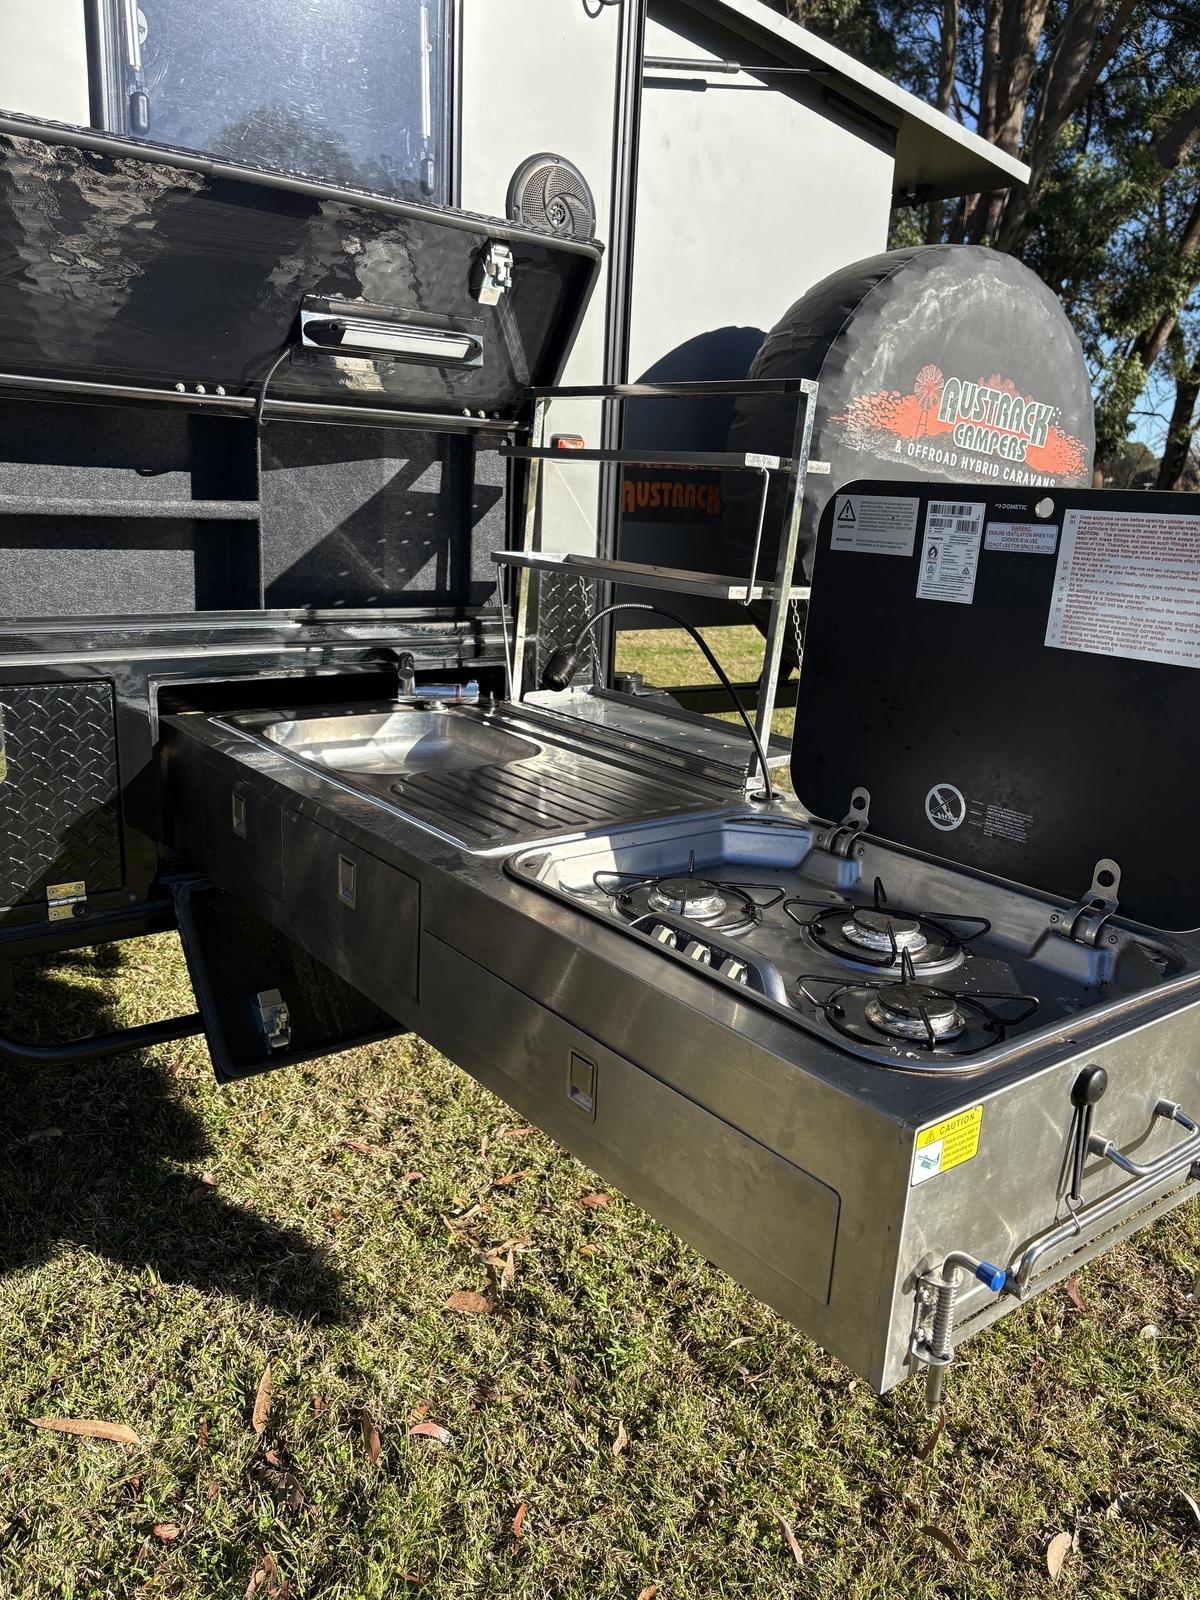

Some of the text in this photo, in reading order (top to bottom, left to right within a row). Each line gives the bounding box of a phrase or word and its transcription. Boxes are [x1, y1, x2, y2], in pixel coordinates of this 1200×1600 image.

[938, 377, 1054, 447] AUSTRACK
[953, 422, 1028, 462] CAMPERS
[895, 440, 1055, 487] & OFFROAD HYBRID CARAVANS
[622, 480, 721, 514] AUSTRACK
[939, 1113, 975, 1135] CAUTION
